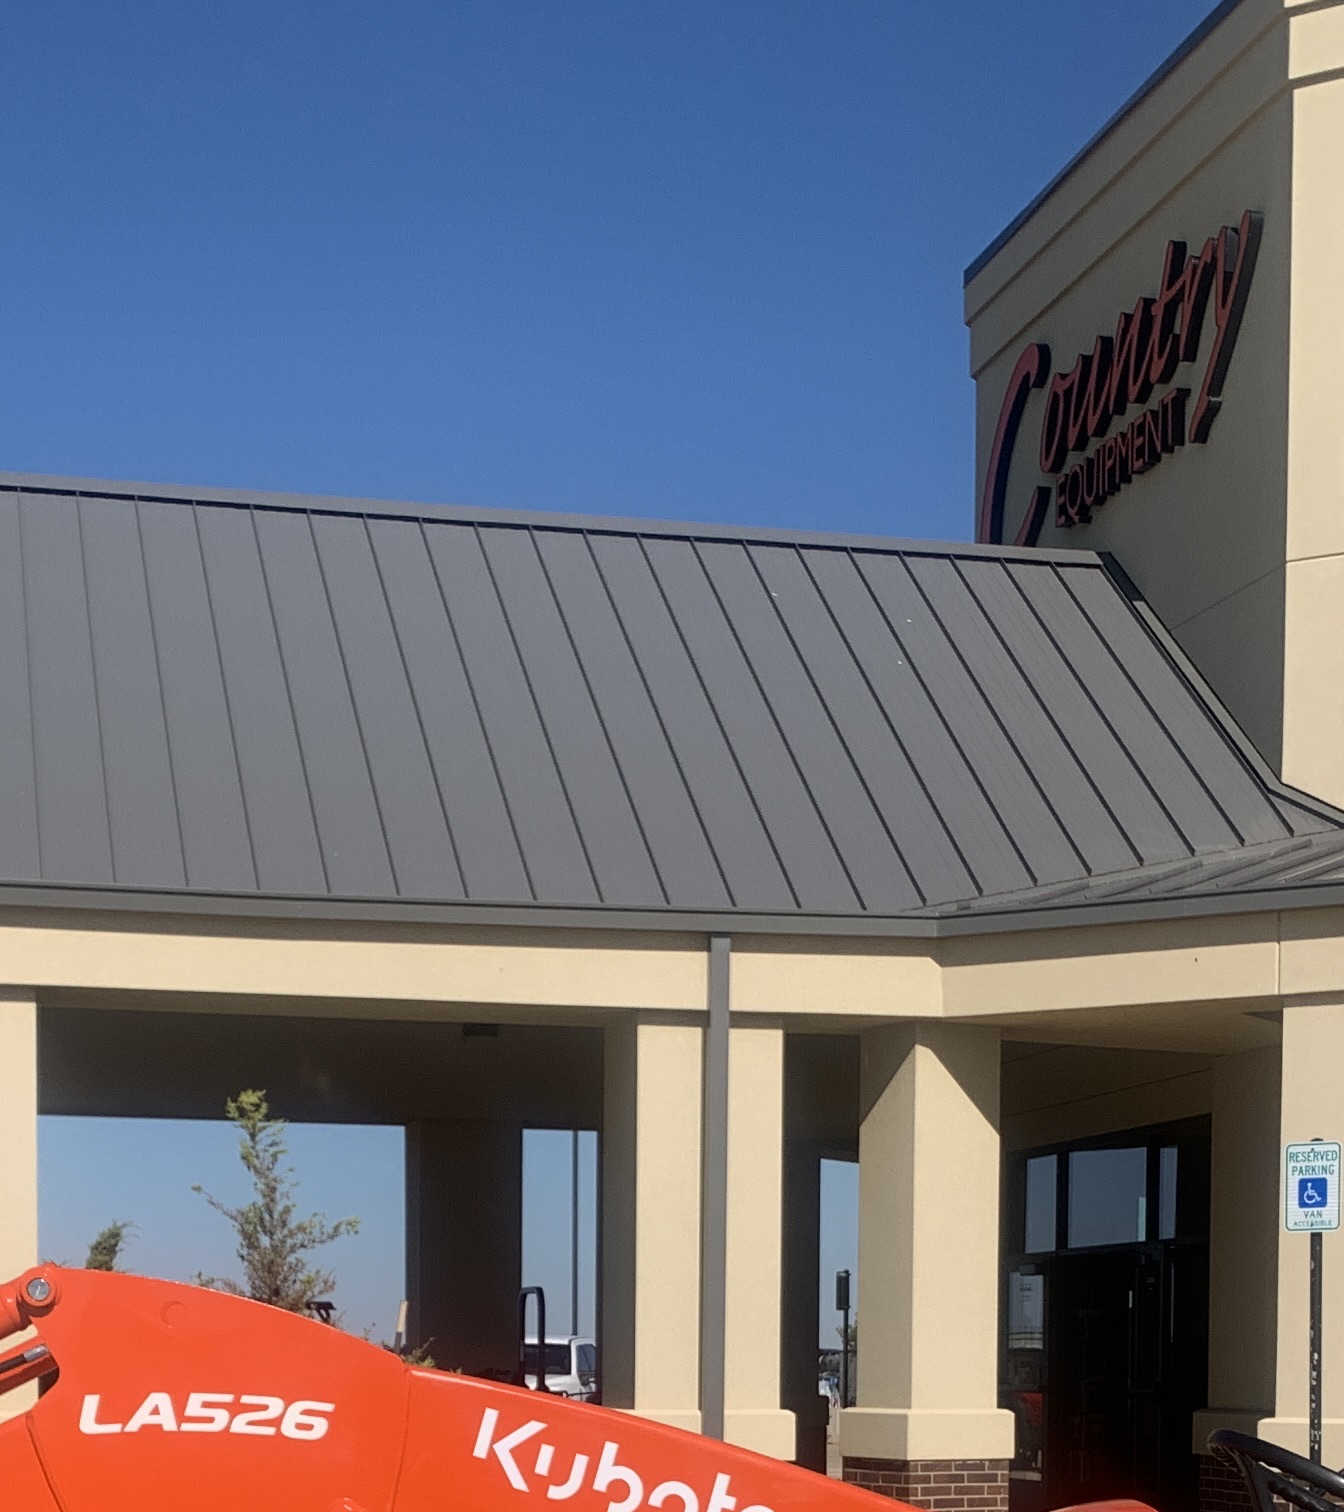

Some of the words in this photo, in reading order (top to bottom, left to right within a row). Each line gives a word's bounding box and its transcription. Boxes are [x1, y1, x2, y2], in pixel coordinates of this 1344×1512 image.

[980, 209, 1263, 546] Country
[1056, 387, 1191, 527] EQUIPMENT
[1289, 1150, 1338, 1163] RESERVED
[1291, 1164, 1336, 1177] PARKING
[1303, 1209, 1323, 1219] VAN
[79, 1392, 335, 1440] LA526
